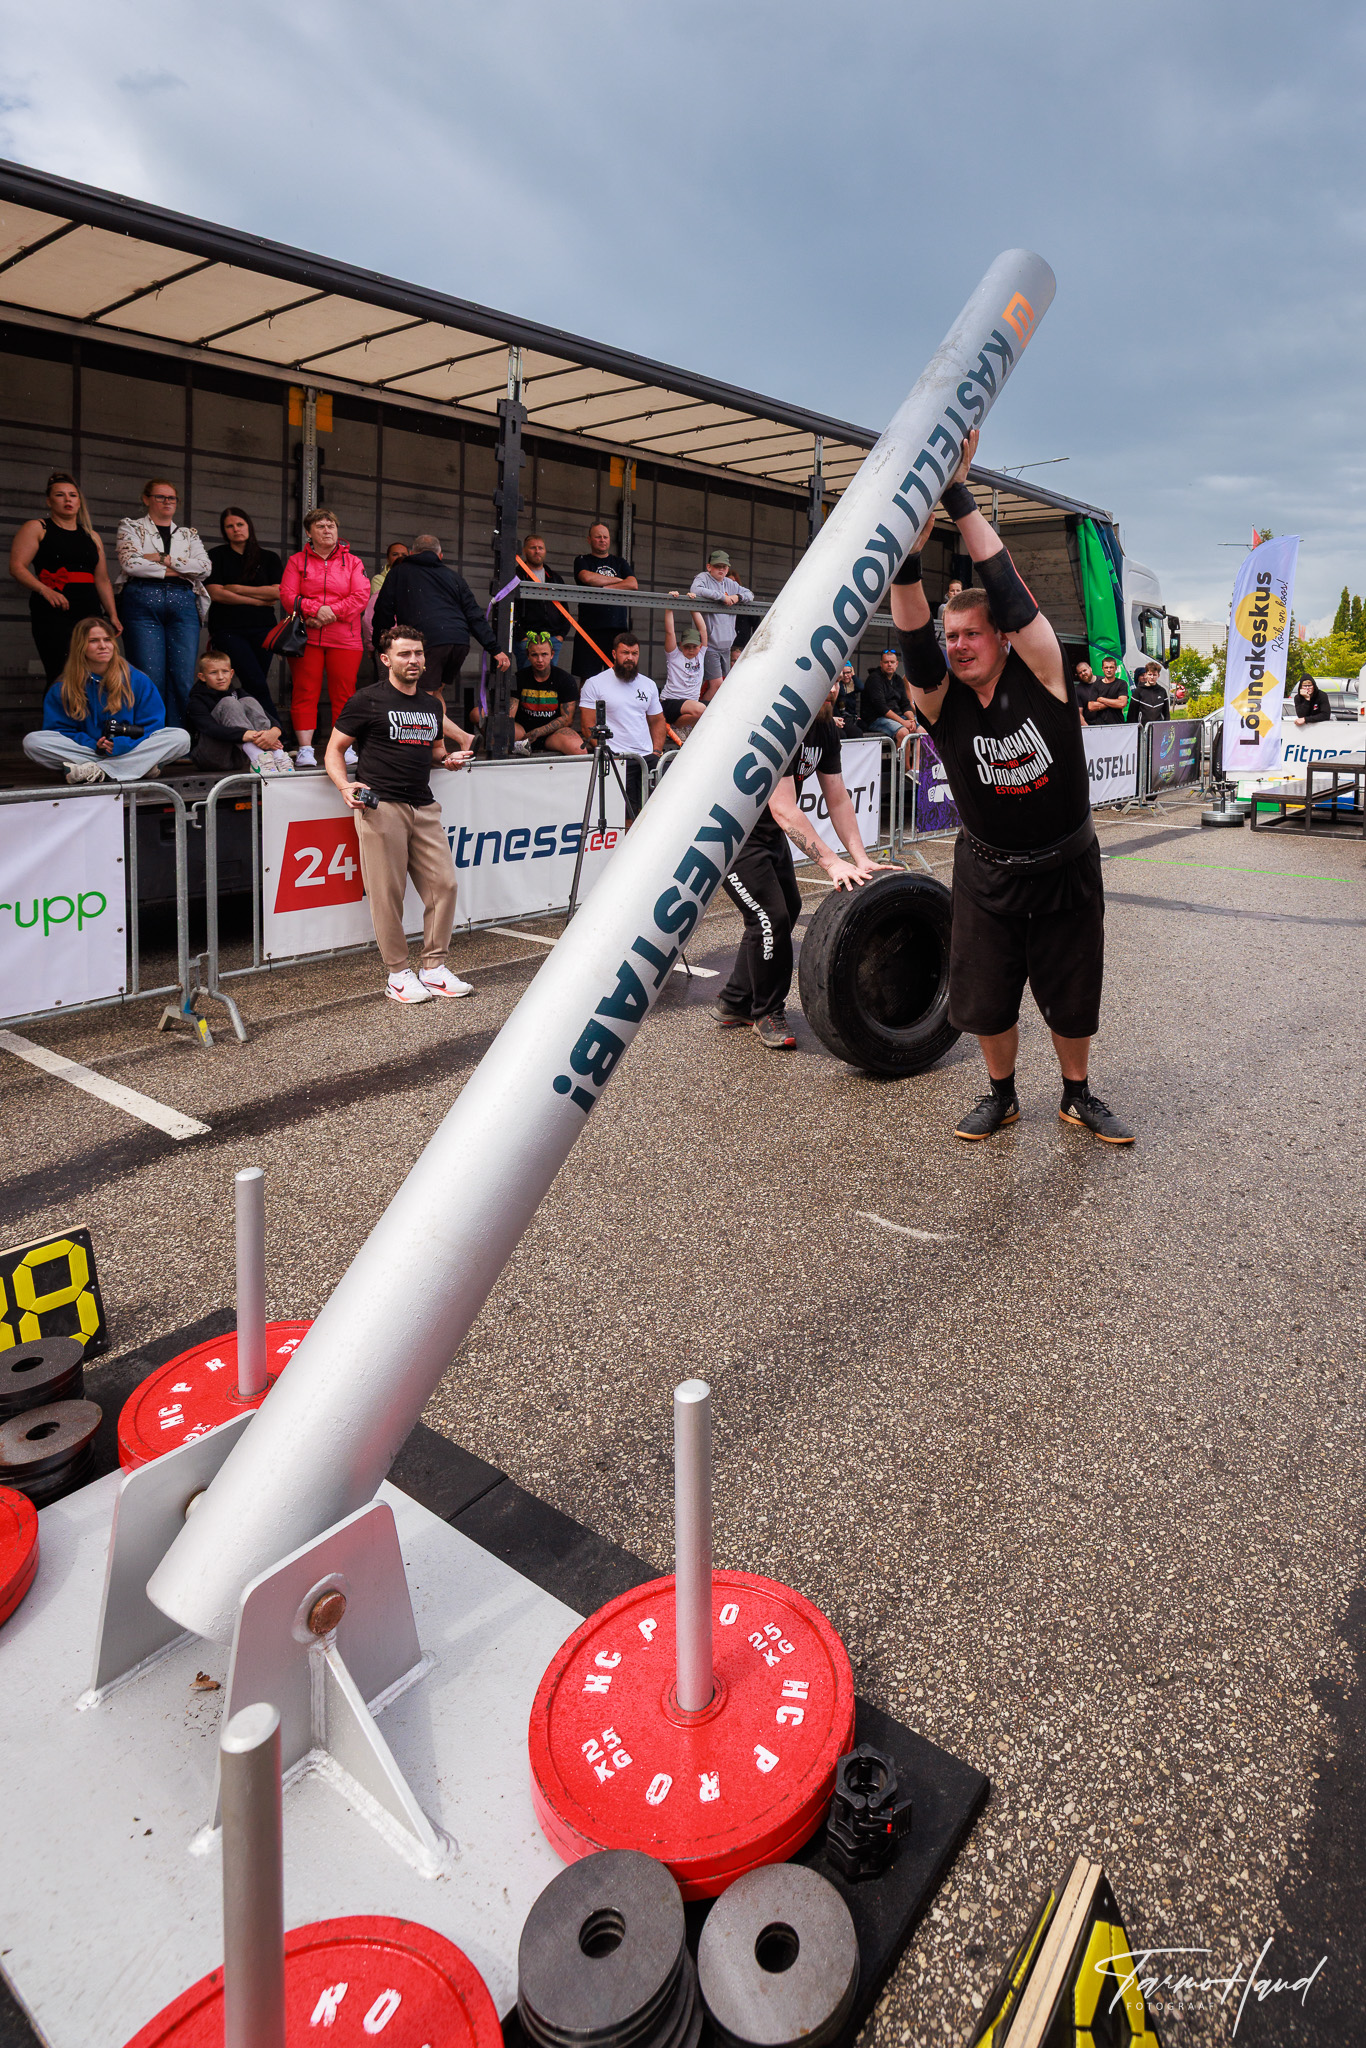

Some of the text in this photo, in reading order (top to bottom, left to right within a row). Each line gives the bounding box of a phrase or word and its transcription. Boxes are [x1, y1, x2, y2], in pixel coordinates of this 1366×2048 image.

[1274, 578, 1289, 608] koos!
[1278, 609, 1286, 624] on
[1239, 571, 1272, 746] Lõunakeskus
[552, 329, 1014, 1114] KASTELLI KODU, MIS KESTAB!
[994, 785, 1032, 795] ESTONIA
[1087, 752, 1136, 782] ASTELLI
[293, 842, 358, 888] 24
[443, 821, 618, 869] itness.ee
[727, 872, 774, 961] RAMMUKOOBAS
[581, 1602, 741, 1695] HC PO
[775, 1679, 810, 1726] HC
